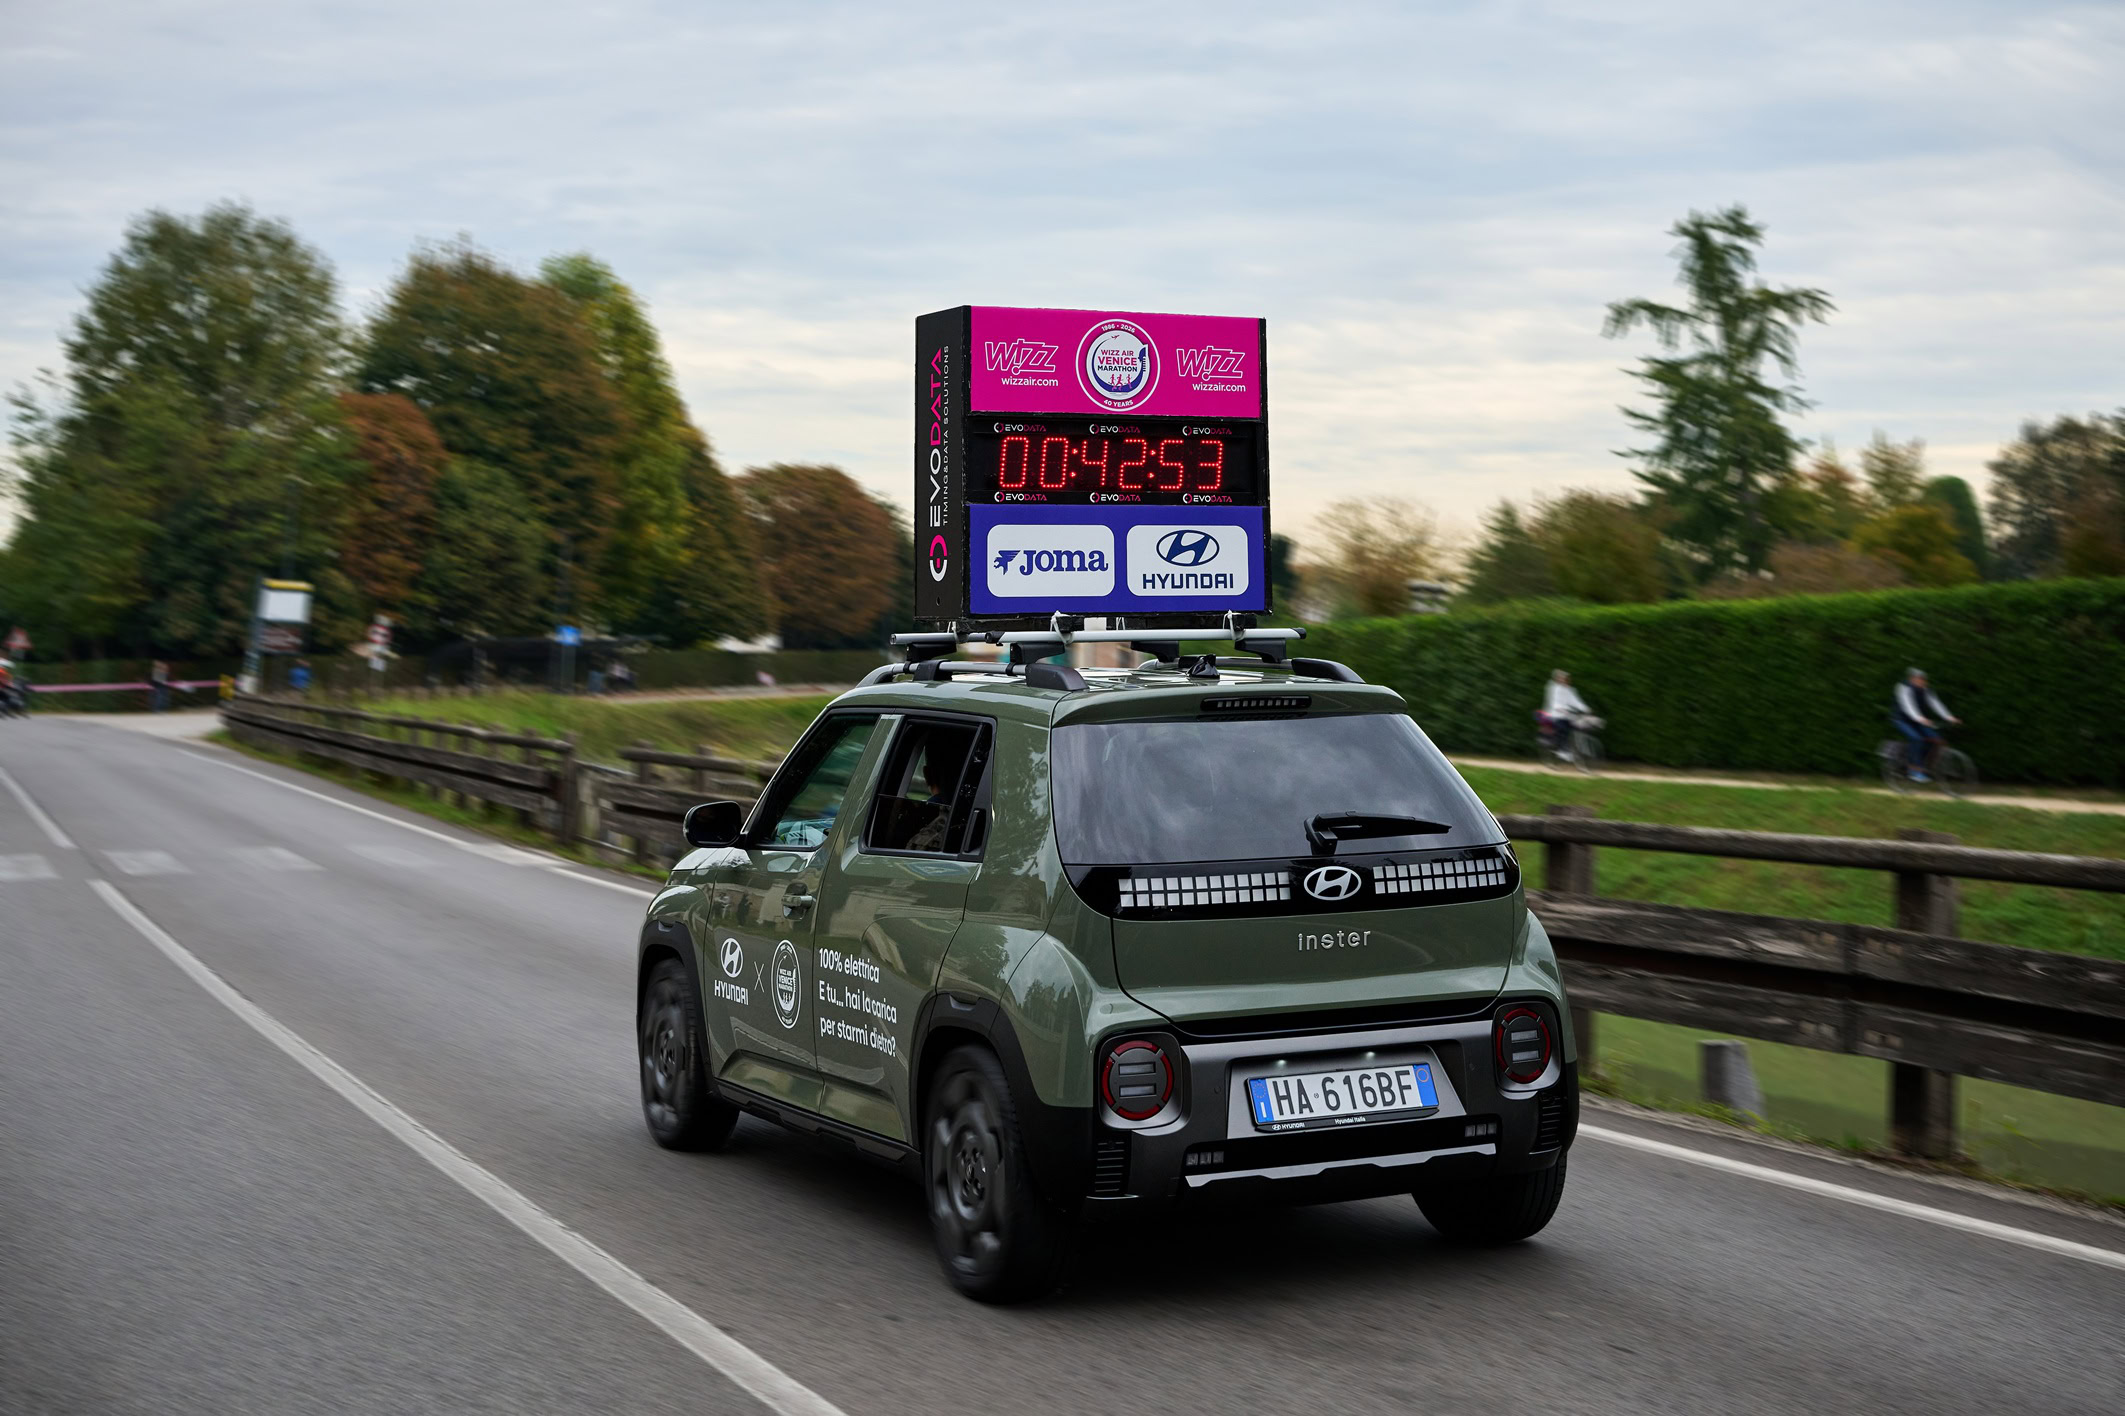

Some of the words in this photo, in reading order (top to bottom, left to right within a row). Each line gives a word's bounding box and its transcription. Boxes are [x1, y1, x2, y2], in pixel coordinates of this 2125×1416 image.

[1098, 356, 1138, 366] VENICE
[1001, 376, 1059, 387] wizzair.com
[1192, 382, 1246, 392] wizzair.com
[1005, 424, 1047, 432] EVODATA
[1100, 425, 1141, 434] EVODATA
[930, 347, 941, 527] EVODATA
[999, 436, 1224, 490] 00:42:53
[1005, 493, 1048, 501] EVODATA
[1101, 493, 1142, 502] EVODATA
[1193, 494, 1233, 503] EVODATA
[1142, 573, 1234, 589] HYUNDAI
[1298, 929, 1371, 951] inster
[819, 948, 843, 972] 100%
[844, 953, 880, 983] elettrica
[714, 979, 749, 1005] HYUNDAI
[819, 980, 825, 1000] E
[826, 983, 844, 1007] tu...
[845, 986, 860, 1010] hai
[862, 990, 871, 1013] la
[871, 997, 897, 1023] carica
[820, 1016, 836, 1036] per
[837, 1019, 869, 1046] starmi
[869, 1027, 897, 1058] dietro?
[1272, 1078, 1314, 1116] HA
[1321, 1069, 1412, 1112] 616BF
[1334, 1117, 1354, 1125] Hyundai
